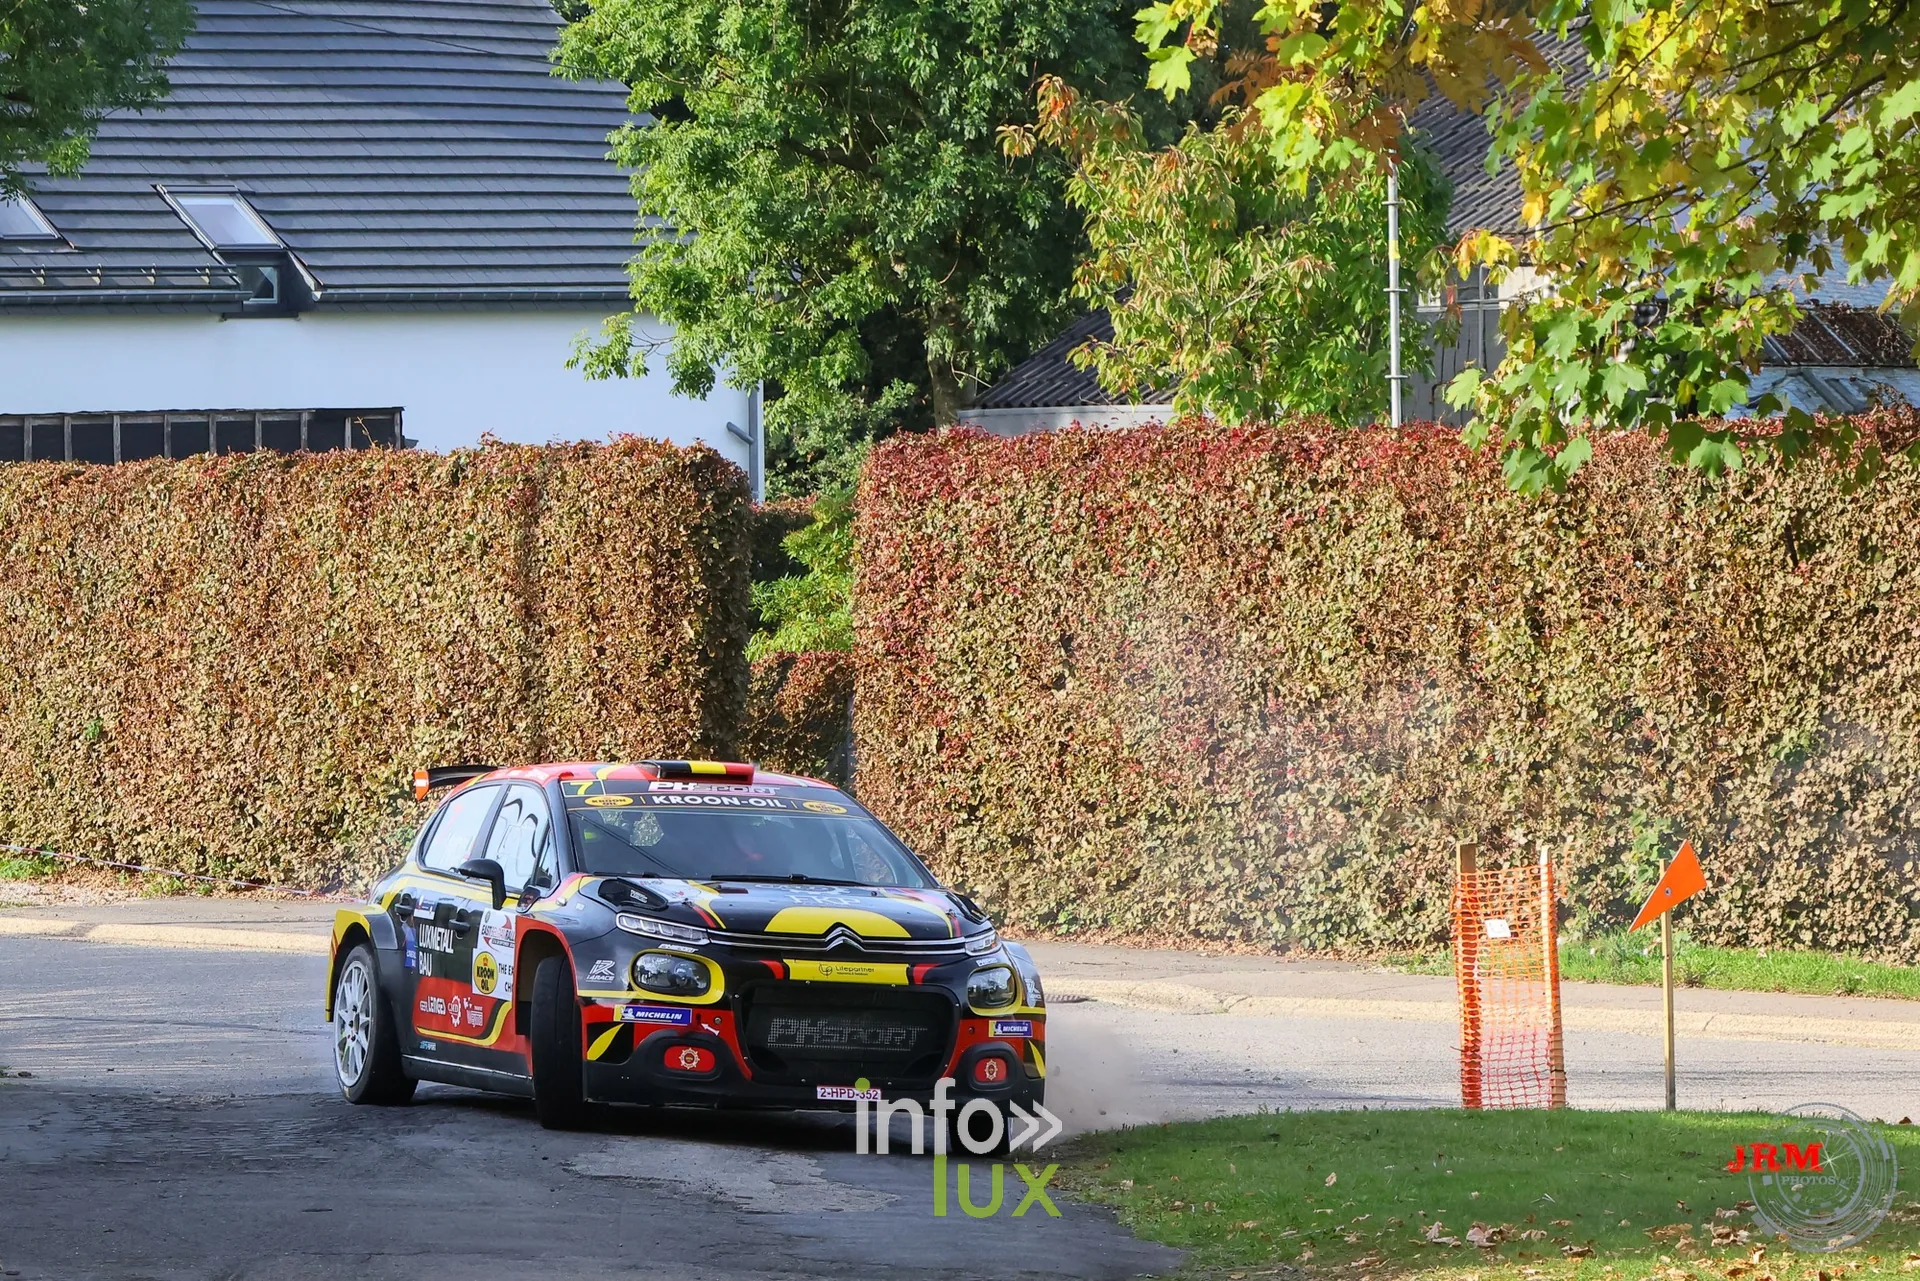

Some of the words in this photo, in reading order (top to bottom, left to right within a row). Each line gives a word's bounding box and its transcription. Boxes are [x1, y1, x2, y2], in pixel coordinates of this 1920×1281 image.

[570, 781, 594, 795] 7
[652, 795, 787, 808] KROON-OIL
[419, 951, 432, 977] BAU
[635, 1010, 683, 1020] MICHELIN
